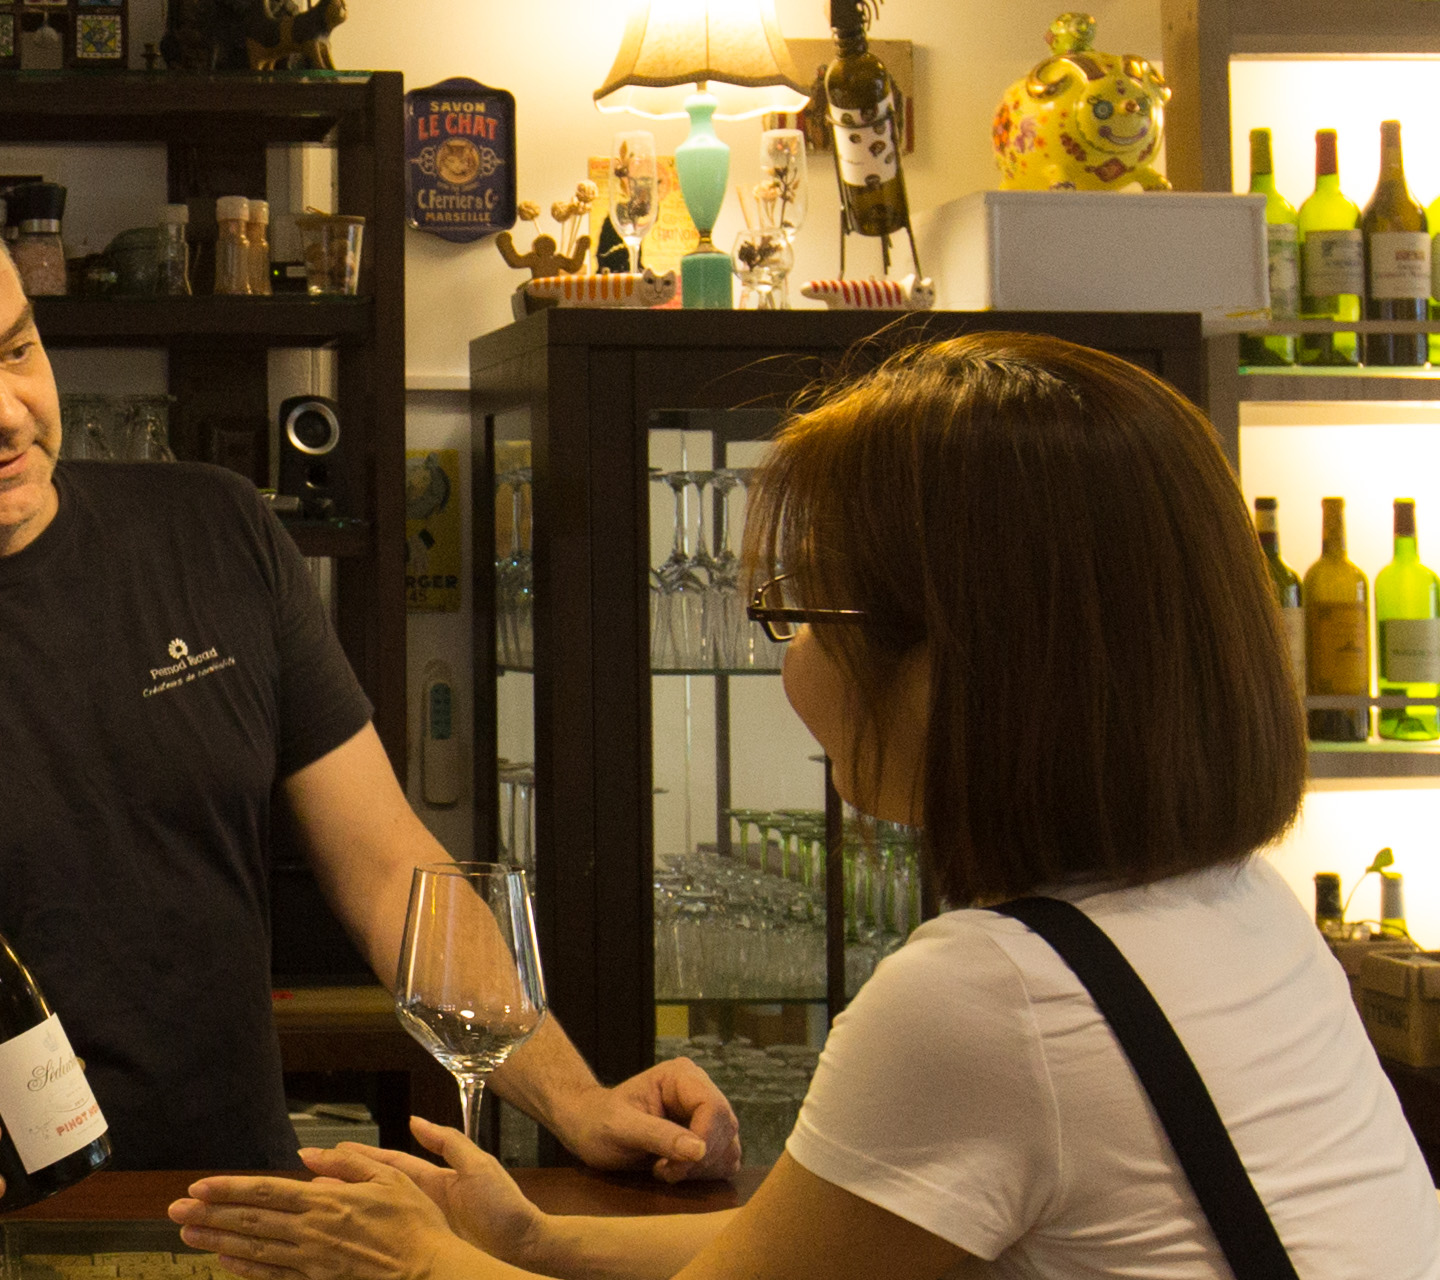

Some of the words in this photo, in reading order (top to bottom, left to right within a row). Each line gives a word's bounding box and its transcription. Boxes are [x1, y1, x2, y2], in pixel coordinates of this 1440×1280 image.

[430, 101, 486, 113] SAVON
[418, 114, 440, 141] LE
[445, 112, 498, 141] CHAT
[425, 212, 492, 223] MARSEILLE
[56, 1111, 88, 1136] PINOT
